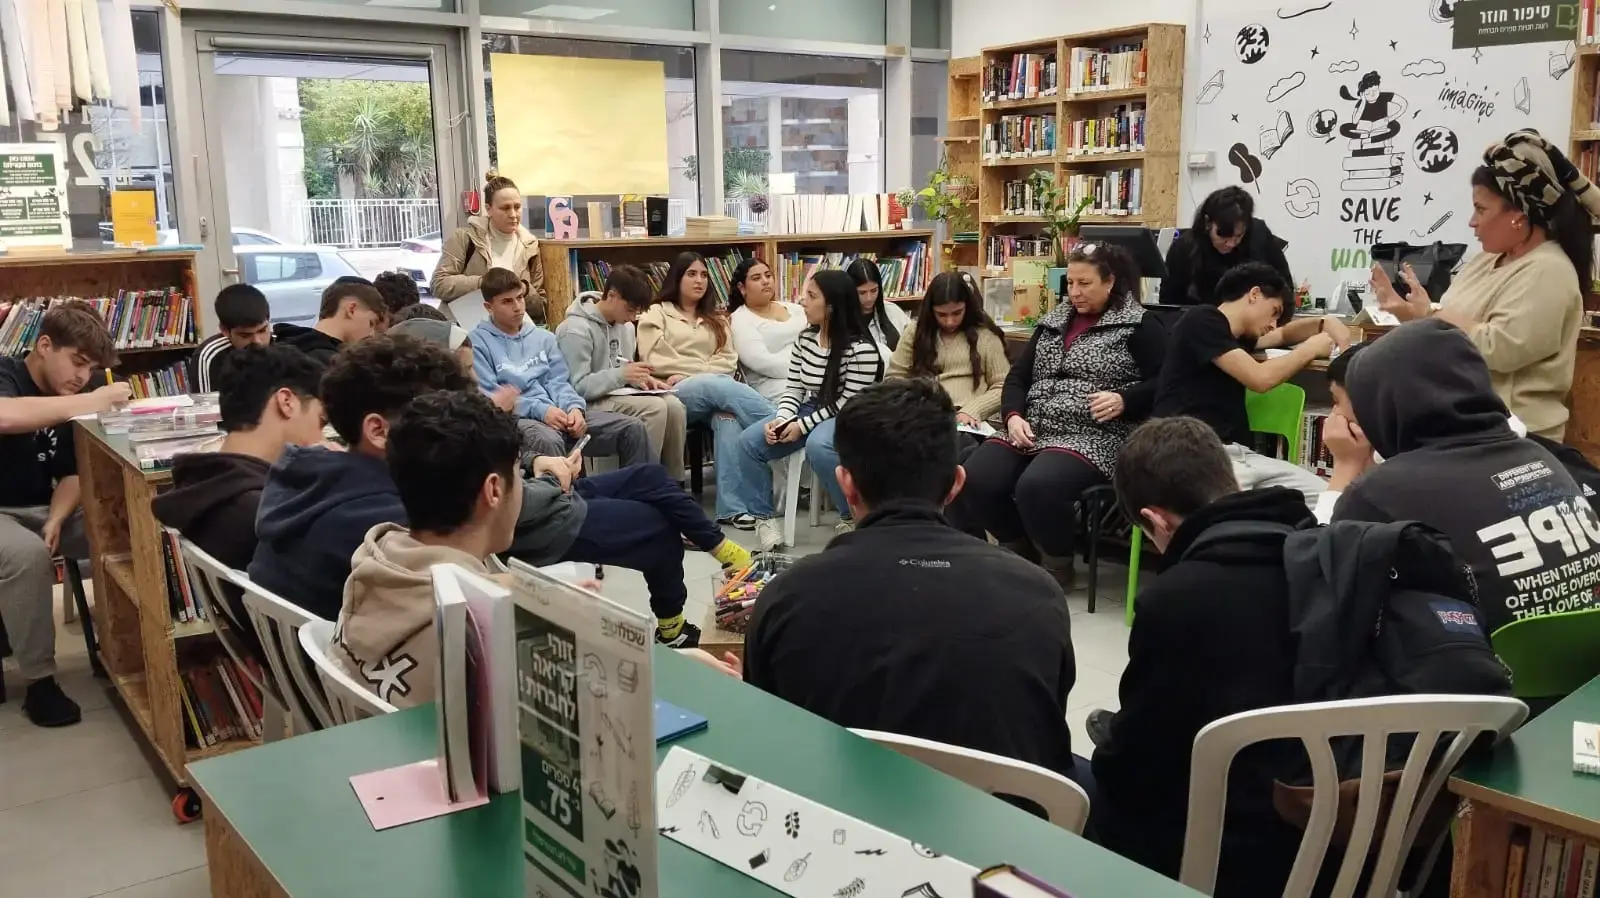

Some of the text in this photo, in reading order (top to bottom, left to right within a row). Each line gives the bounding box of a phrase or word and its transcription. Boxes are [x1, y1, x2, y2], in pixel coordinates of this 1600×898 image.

[1479, 5, 1550, 24] סיפור חוזר
[1340, 197, 1401, 223] SAVE
[1353, 228, 1383, 245] THE
[1498, 464, 1531, 481] DIFFERENT
[1498, 478, 1516, 489] AND
[1513, 567, 1560, 592] WHEN
[1560, 560, 1583, 578] THE
[1505, 594, 1530, 609] OF
[1532, 582, 1569, 604] LOVE
[1512, 605, 1545, 621] THE
[1548, 594, 1581, 615] LOVE
[1580, 588, 1593, 604] OF
[546, 632, 575, 663] זוהי
[533, 651, 576, 694] קריאה
[518, 670, 577, 720] לחברות!
[541, 759, 580, 795] 4 ספרים
